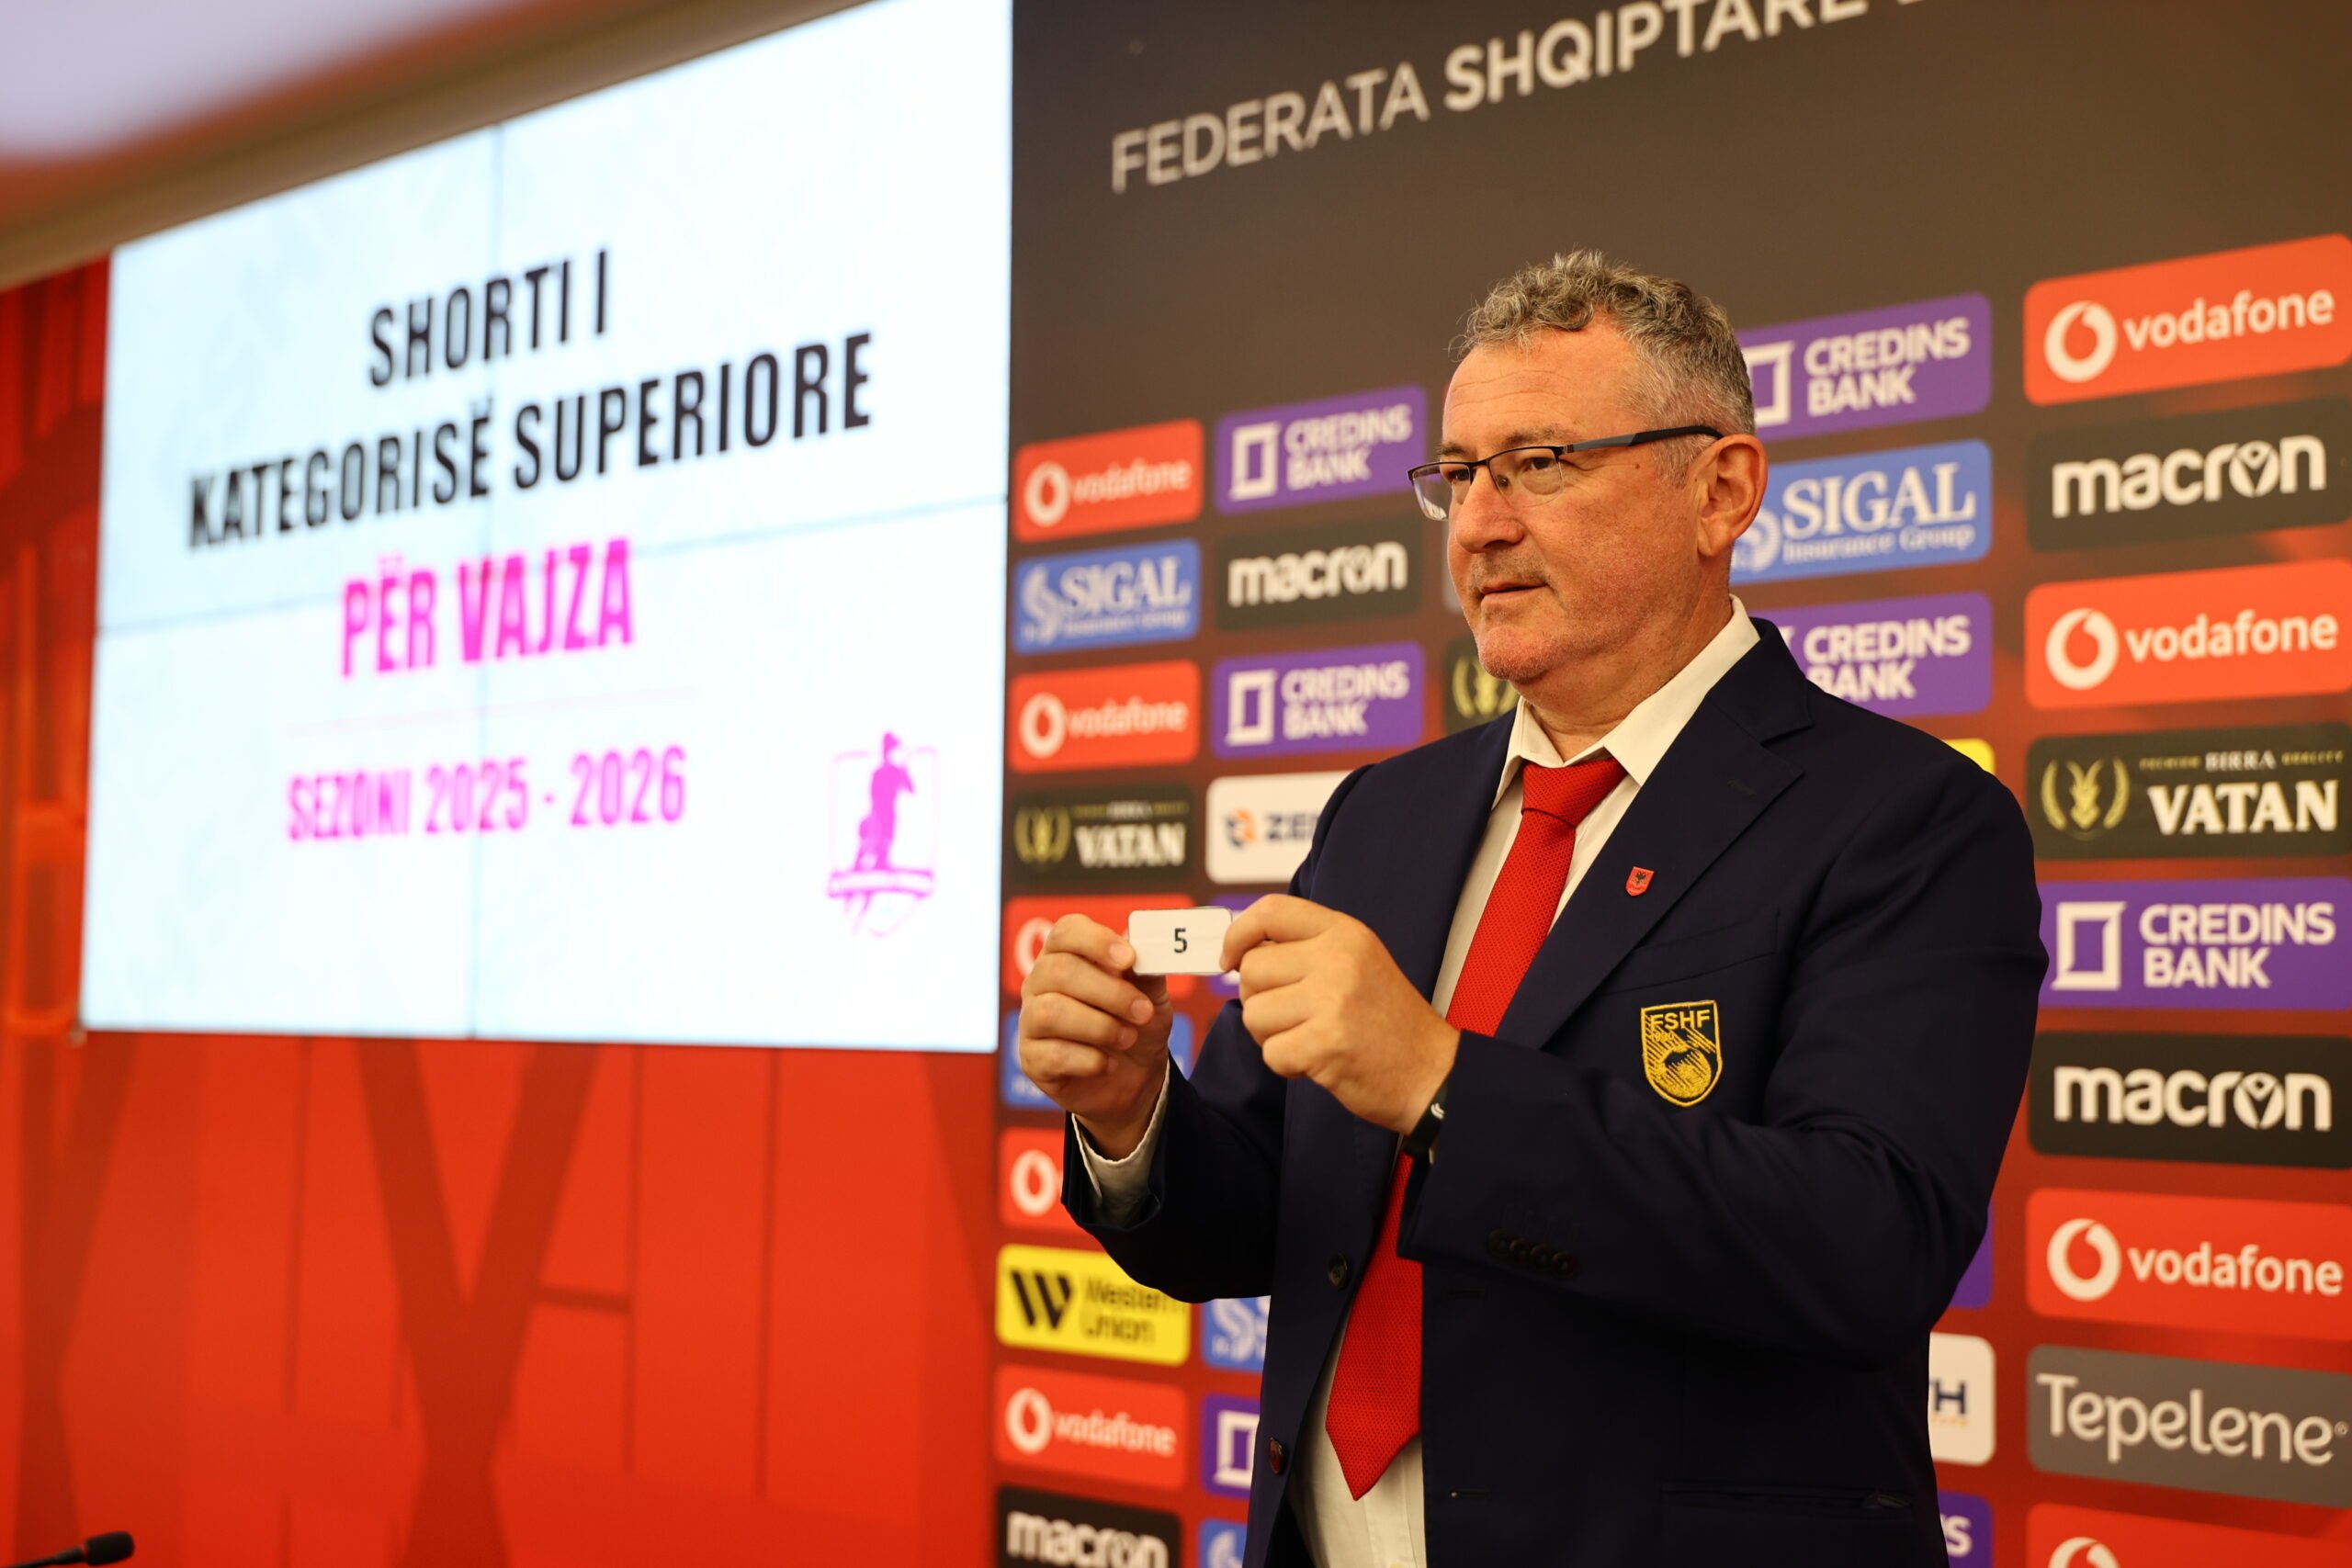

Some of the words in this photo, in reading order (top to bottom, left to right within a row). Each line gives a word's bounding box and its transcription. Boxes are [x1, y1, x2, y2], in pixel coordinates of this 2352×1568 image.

[1111, 61, 1430, 193] FEDERATA
[370, 259, 571, 386] SHORTI
[594, 248, 608, 334] I
[2123, 288, 2335, 353] vodafone
[1804, 317, 1972, 380] CREDINS
[1806, 367, 1917, 418] BANK
[188, 398, 494, 548] KATEGORISË
[513, 332, 873, 490] SUPERIORE
[1285, 403, 1413, 454] CREDINS
[1072, 457, 1192, 504] vodafone
[1287, 447, 1373, 491] BANK
[2051, 434, 2328, 520] macron
[1782, 462, 1976, 540] SIGAL
[1060, 557, 1192, 617] SIGAL
[1228, 541, 1408, 606] macron
[342, 555, 437, 678] PËR
[459, 538, 636, 663] VAJZA
[1804, 615, 1973, 665] CREDINS
[2125, 609, 2339, 663] vodafone
[1282, 661, 1409, 700] CREDINS
[1806, 658, 1917, 702] BANK
[1065, 695, 1190, 738] vodafone
[1285, 698, 1368, 739] BANK
[2205, 750, 2278, 772] BIRRA
[288, 770, 412, 841] SEZONI
[424, 759, 529, 836] 2025
[571, 746, 687, 827] 2026
[2146, 778, 2340, 836] VATAN
[1074, 822, 1186, 868] VATAN
[1173, 928, 1188, 953] 5
[2139, 902, 2335, 946] CREDINS
[2143, 946, 2271, 988] BANK
[1650, 1009, 1711, 1032] FSHF
[2053, 1066, 2332, 1132] macron
[2128, 1241, 2344, 1296] vodafone
[1053, 1408, 1177, 1458] vodafone
[1007, 1511, 1169, 1568] macron
